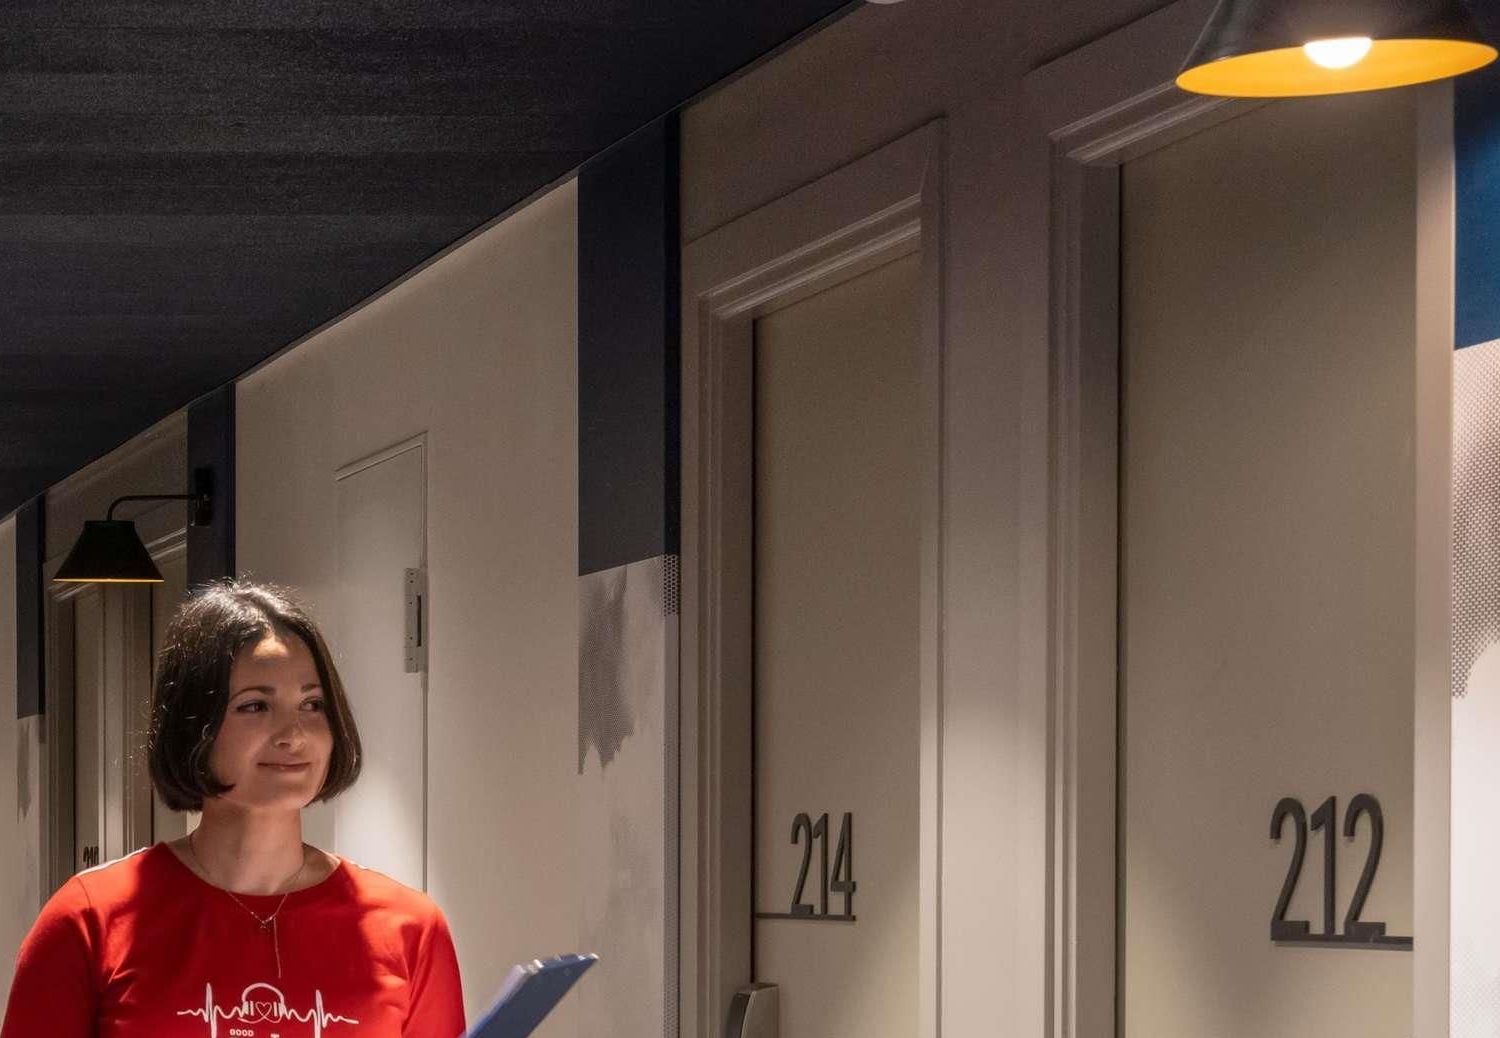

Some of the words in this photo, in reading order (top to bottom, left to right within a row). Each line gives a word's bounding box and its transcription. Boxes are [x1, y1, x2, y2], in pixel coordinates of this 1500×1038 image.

[790, 812, 857, 916] 214
[1270, 793, 1387, 938] 212
[229, 1028, 255, 1037] GOOD
